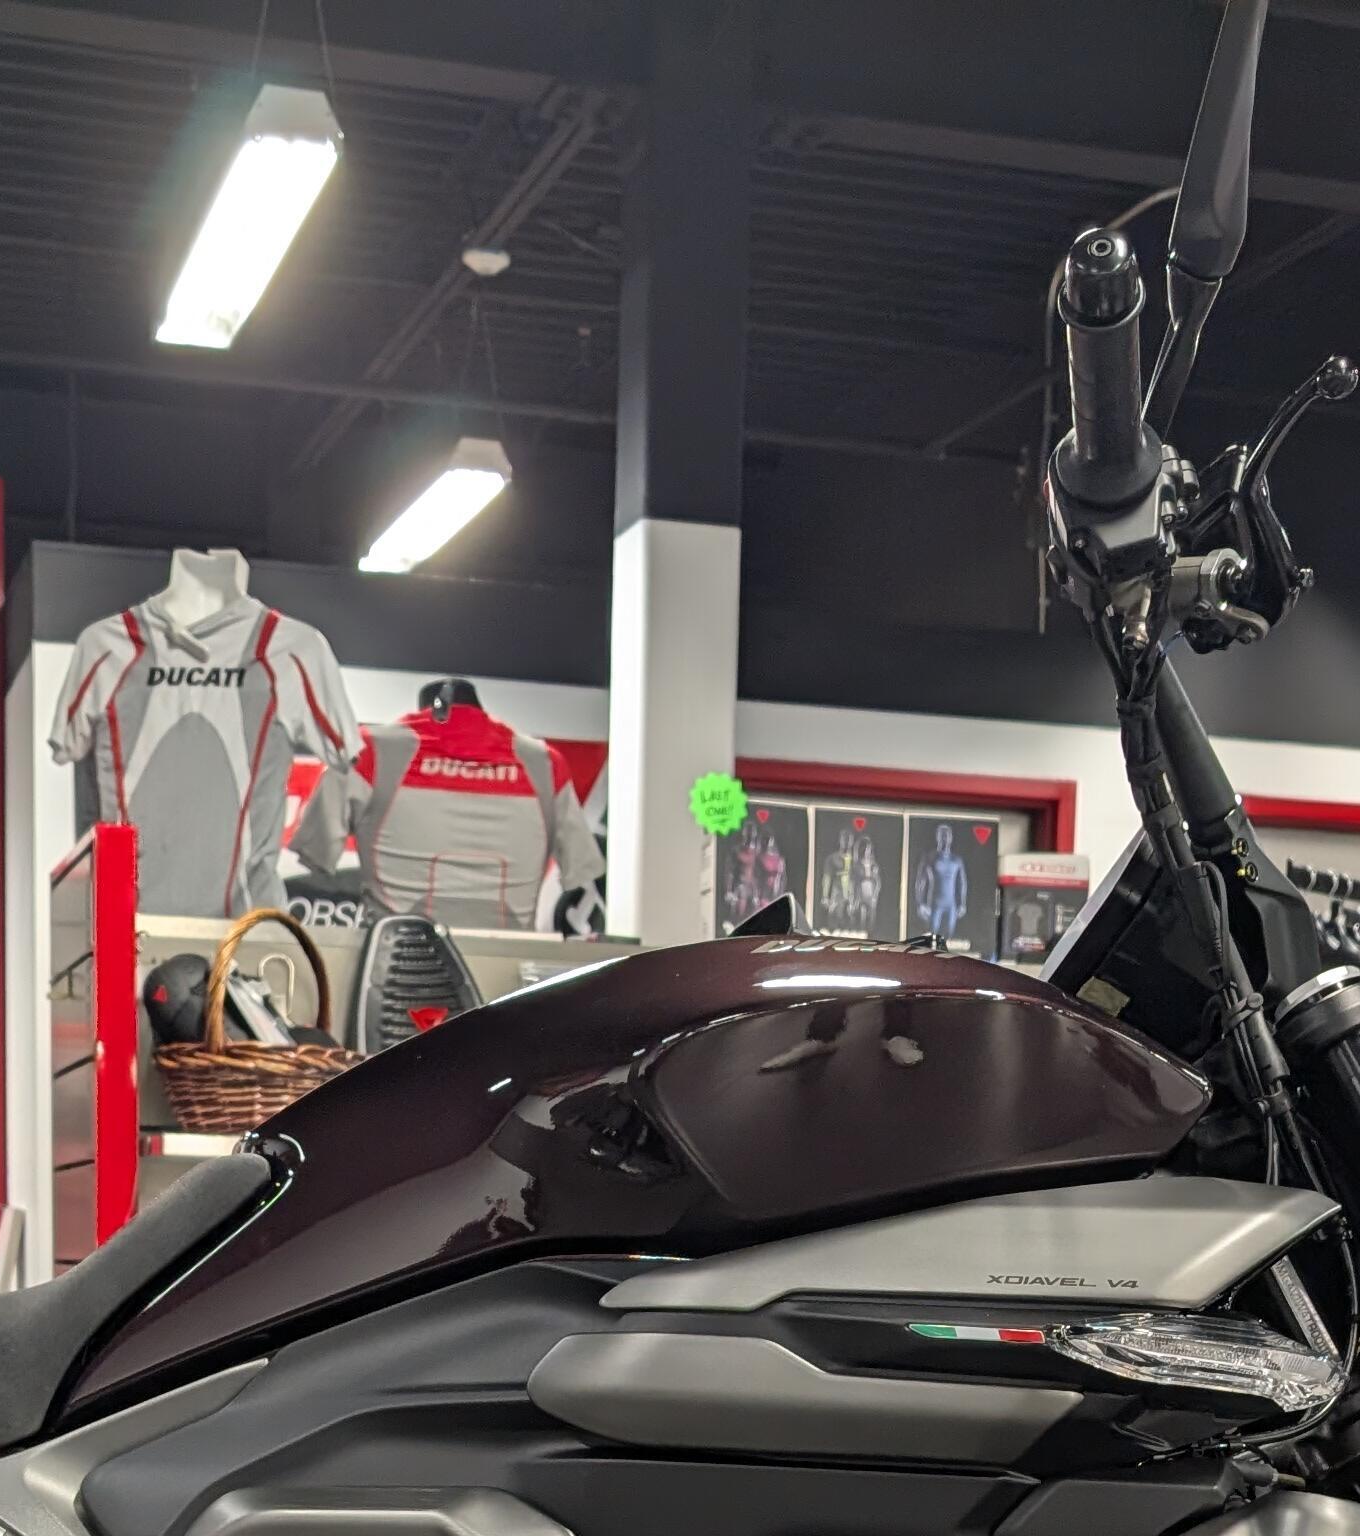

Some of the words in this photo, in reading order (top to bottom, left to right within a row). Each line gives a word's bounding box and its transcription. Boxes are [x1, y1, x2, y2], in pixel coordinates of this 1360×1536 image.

[147, 667, 246, 688] DUCATI
[419, 757, 520, 781] DUCATI
[987, 1274, 1097, 1288] XDIAVEL
[1107, 1278, 1139, 1289] V4
